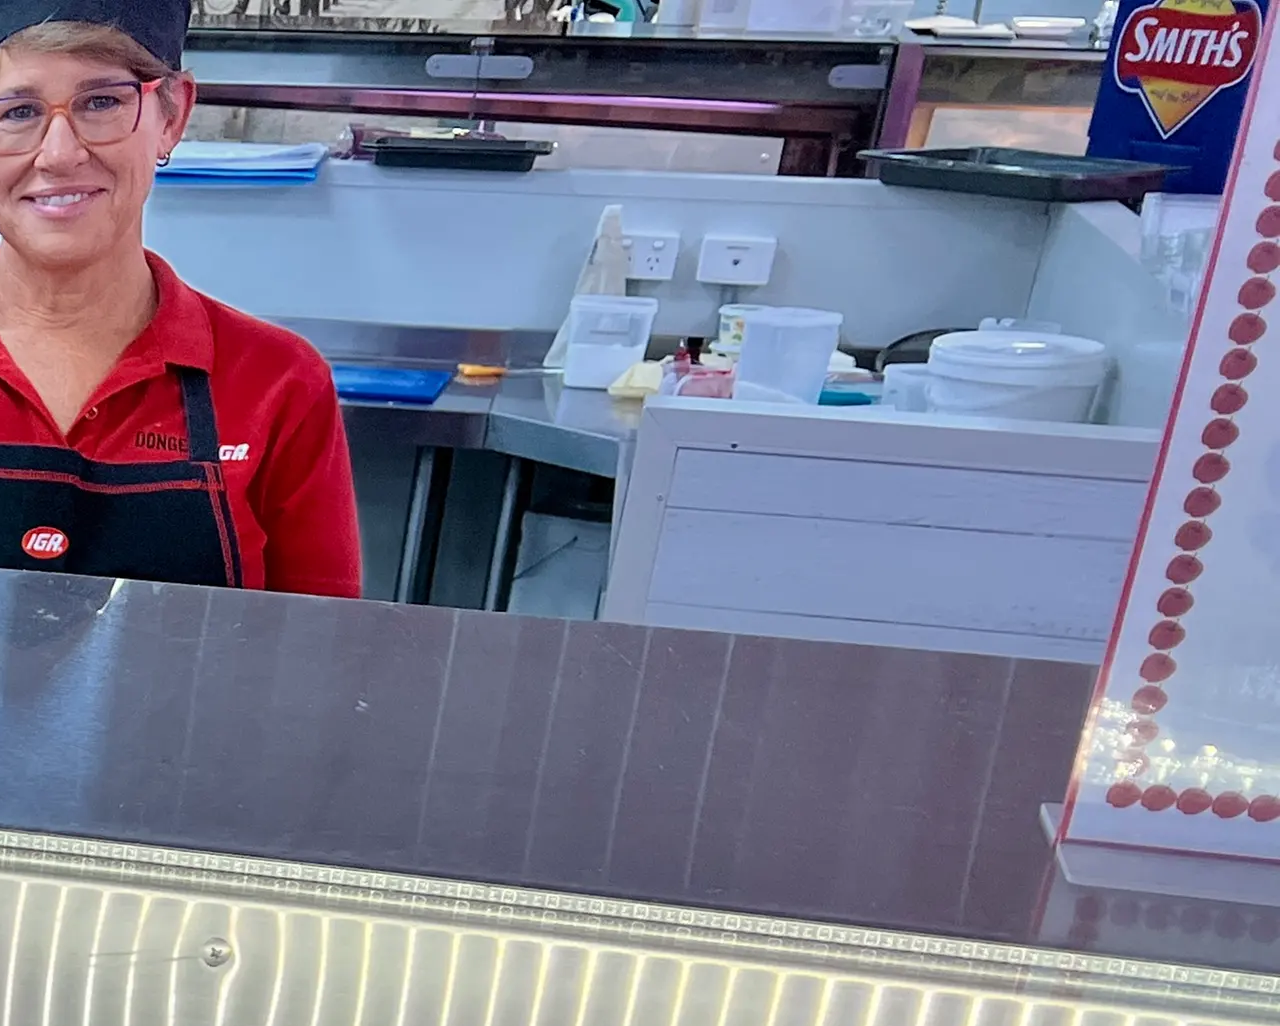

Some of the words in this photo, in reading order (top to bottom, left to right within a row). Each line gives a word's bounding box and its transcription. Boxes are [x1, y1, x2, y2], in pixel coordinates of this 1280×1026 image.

[1124, 17, 1249, 67] SMITH'S
[135, 431, 188, 452] DONGE
[218, 443, 249, 460] GA
[26, 533, 63, 552] IGA
